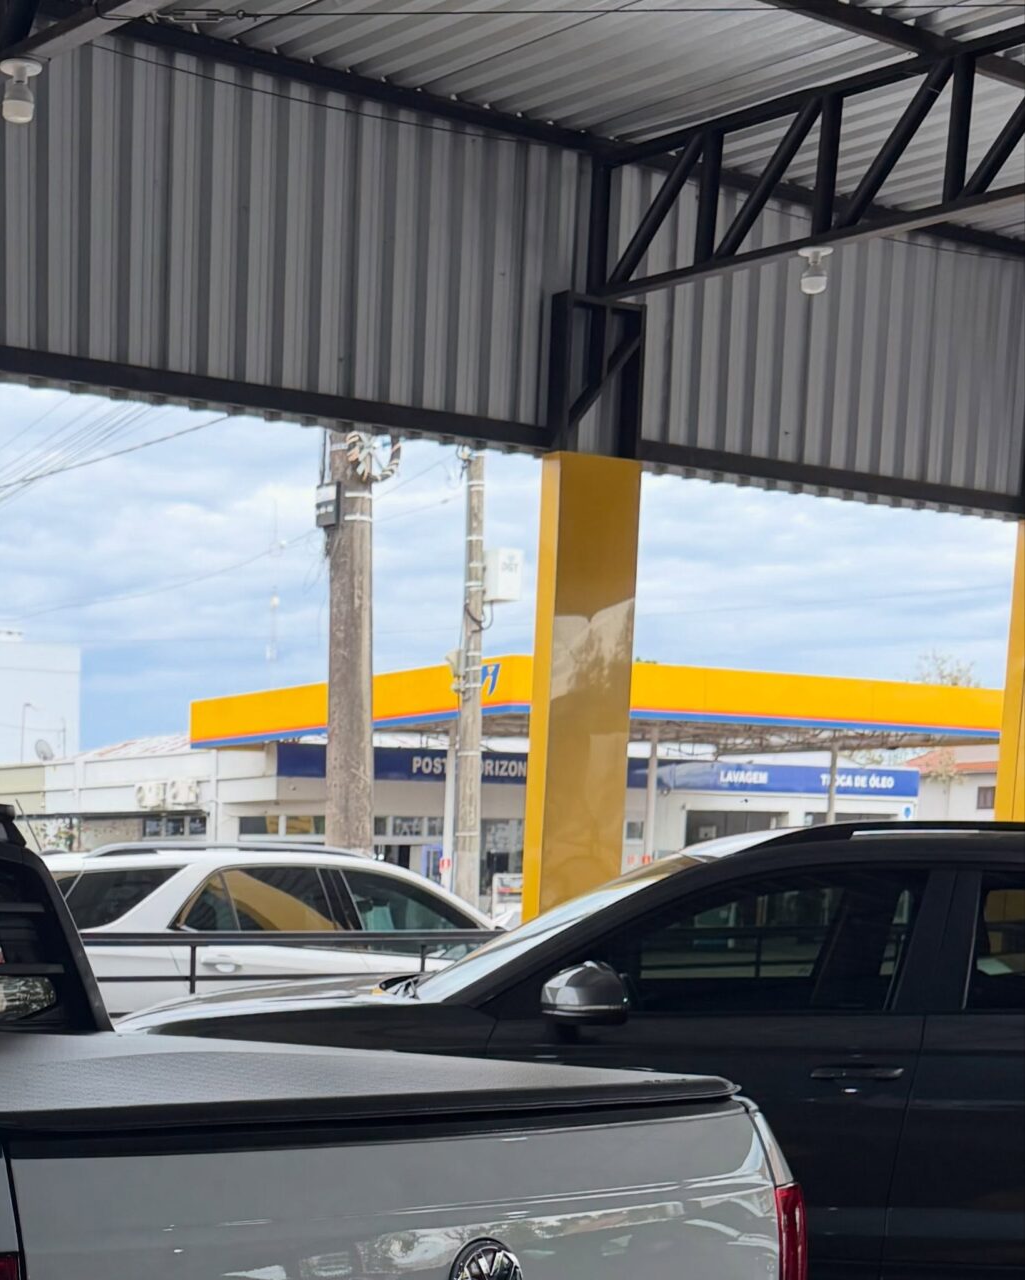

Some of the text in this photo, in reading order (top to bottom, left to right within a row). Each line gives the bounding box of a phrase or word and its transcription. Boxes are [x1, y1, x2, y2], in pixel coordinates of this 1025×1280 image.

[412, 756, 447, 775] POST
[720, 770, 769, 785] LAVAGEM
[820, 772, 895, 789] TOCA DE ÓLEO
